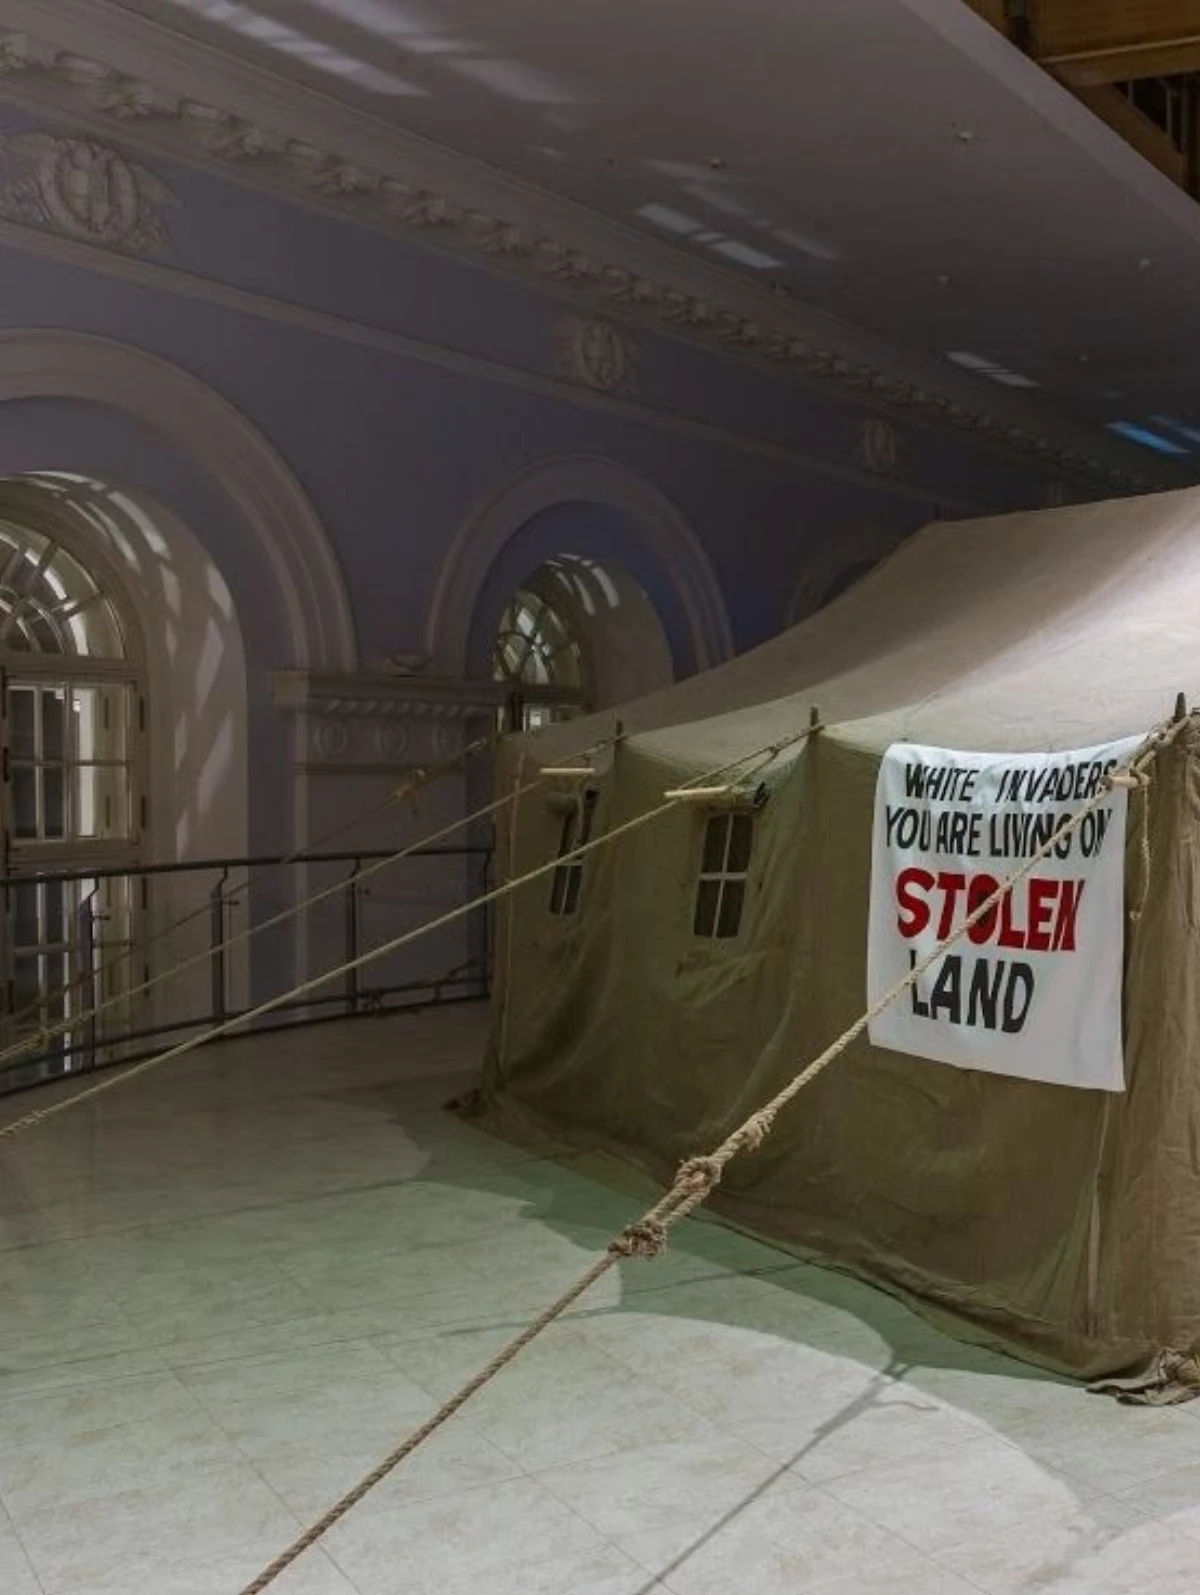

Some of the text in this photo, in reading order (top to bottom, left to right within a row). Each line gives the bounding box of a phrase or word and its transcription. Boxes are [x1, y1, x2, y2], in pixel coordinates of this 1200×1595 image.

[905, 763, 979, 801] WHITE
[885, 805, 1113, 859] YOU ARE LIVING ON
[895, 867, 1085, 952] STOLEN
[909, 949, 1035, 1033] LAND
